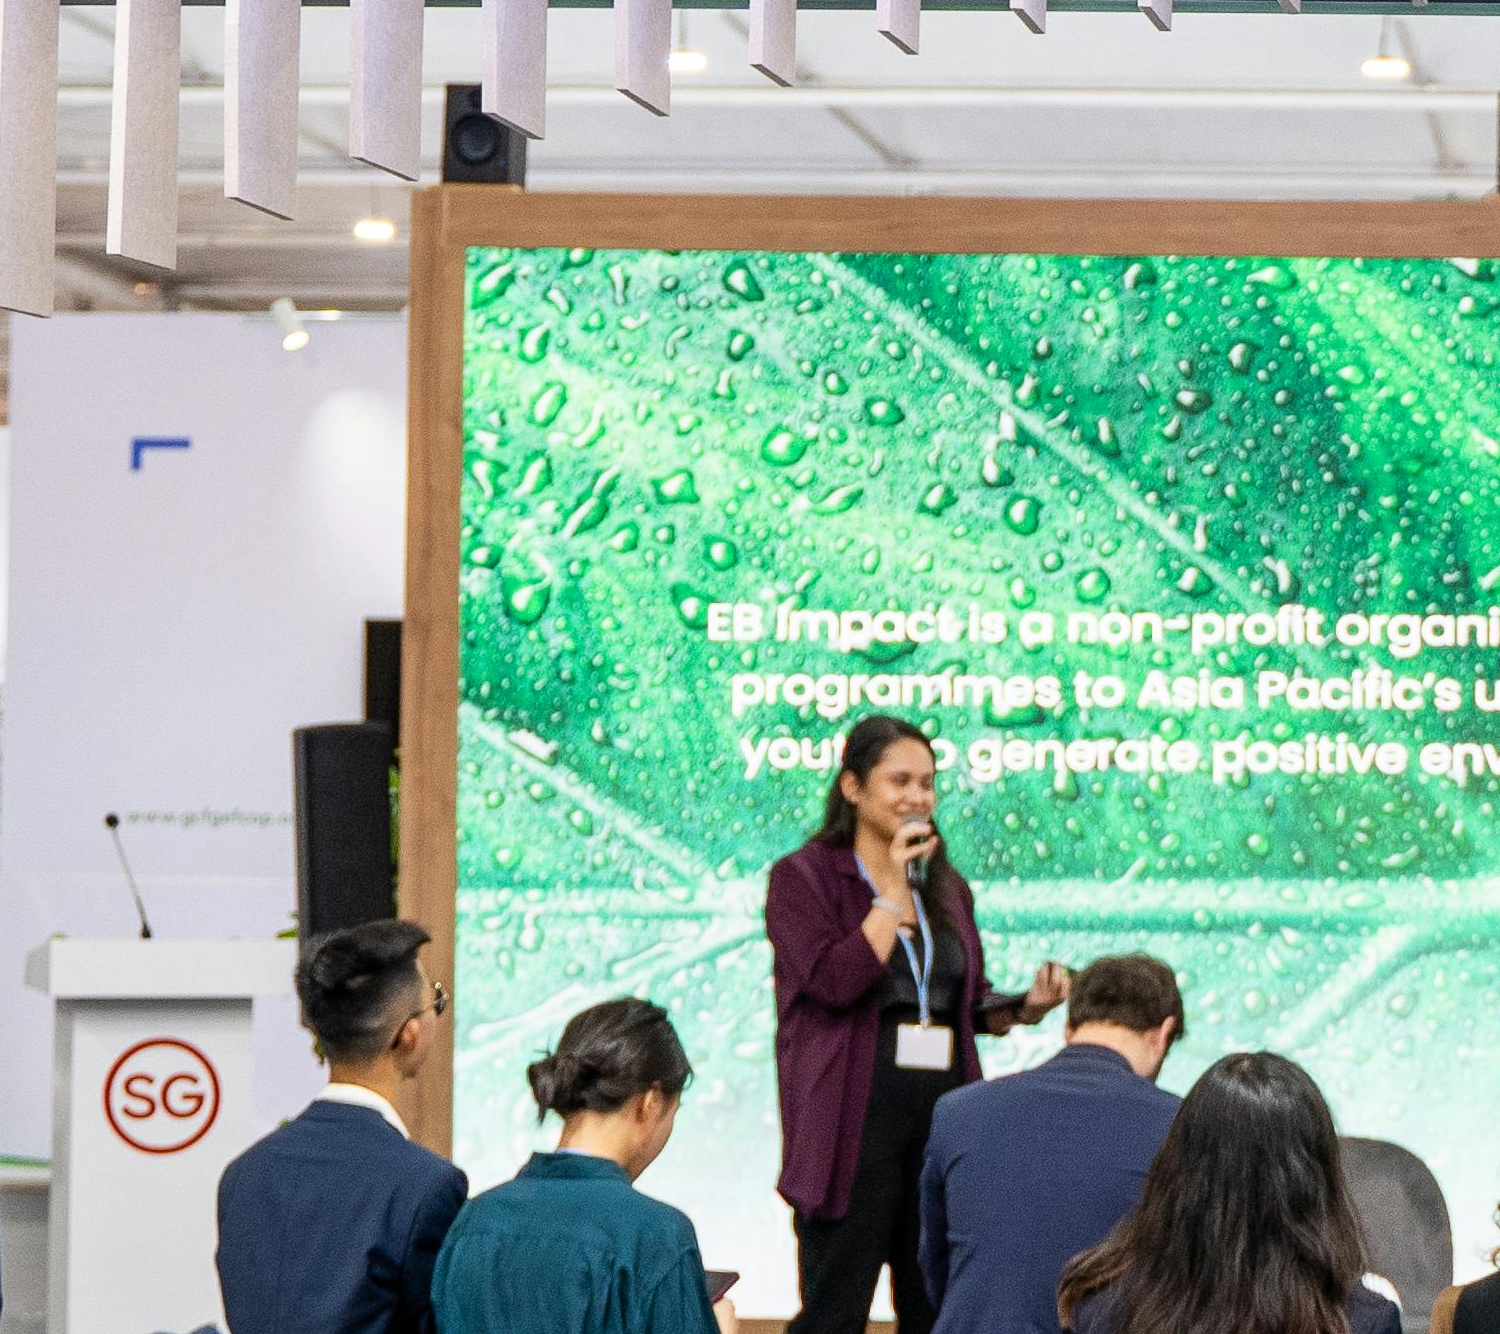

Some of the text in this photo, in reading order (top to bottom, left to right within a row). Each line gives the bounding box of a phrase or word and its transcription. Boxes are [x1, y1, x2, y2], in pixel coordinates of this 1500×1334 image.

[707, 602, 763, 642] EB
[775, 601, 959, 653] Impact
[968, 602, 1007, 644] is
[1019, 613, 1054, 645] a
[1067, 604, 1324, 653] non-profit
[731, 672, 1062, 717] programmes
[1073, 673, 1126, 709] to
[1136, 669, 1244, 710] Asia
[1256, 668, 1462, 712] Pacific's
[967, 734, 1199, 783] generate
[1213, 733, 1407, 784] positive
[121, 1072, 206, 1119] SG
